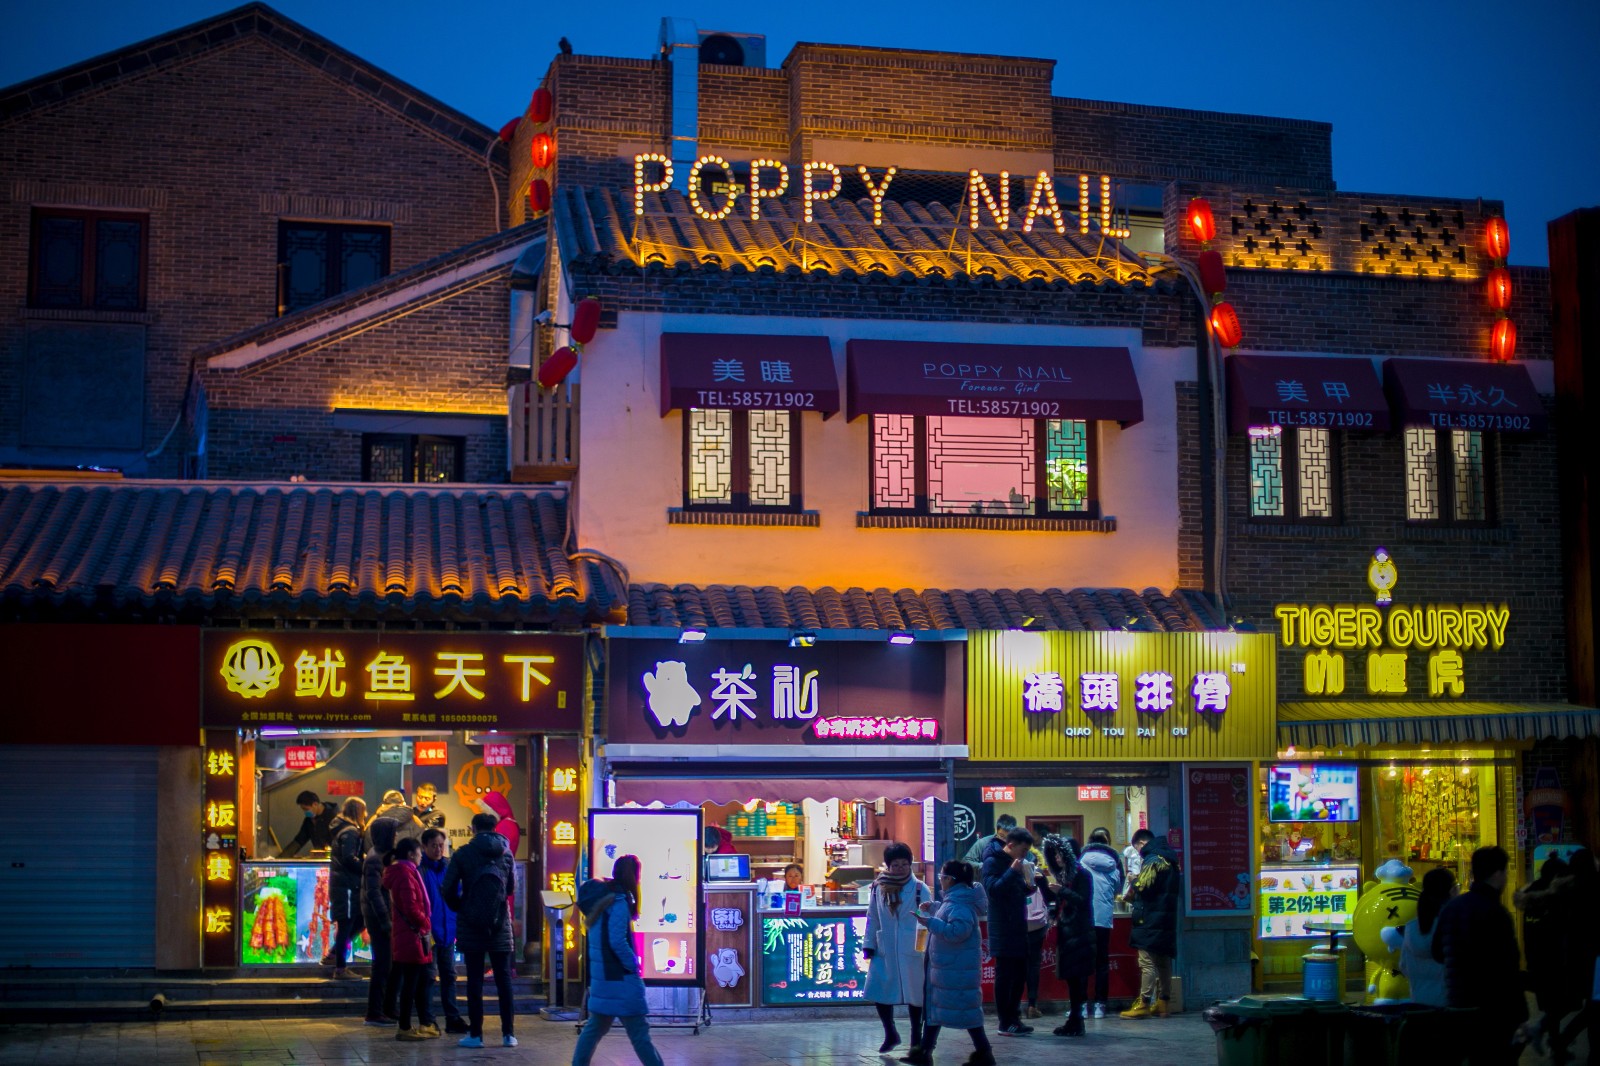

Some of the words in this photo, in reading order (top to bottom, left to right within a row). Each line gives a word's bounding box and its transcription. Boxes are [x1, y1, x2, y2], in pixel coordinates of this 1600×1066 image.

[633, 153, 898, 226] POPPY
[968, 167, 1131, 239] NAIL
[711, 357, 794, 384] 美睫
[923, 362, 1003, 379] POPPY
[1017, 365, 1072, 381] NAIL
[1014, 382, 1040, 395] Girl
[1275, 379, 1351, 404] 美甲
[1428, 381, 1518, 408] 半永久
[697, 390, 815, 408] TEL:58571902
[947, 398, 1060, 416] TEL:58571902
[1268, 410, 1374, 427] TEL:58571902
[1429, 412, 1531, 430] TEL:58571902
[1275, 606, 1383, 648] TIGER
[1387, 607, 1511, 648] CURRY
[293, 647, 556, 703] 鱿鱼天下
[1023, 672, 1231, 712] 橋頭排骨
[1065, 727, 1092, 737] QIAO
[1103, 727, 1125, 737] TOU
[1137, 728, 1156, 737] PAI
[287, 750, 317, 762] 出餐区
[418, 748, 445, 760] 点餐区
[985, 792, 1014, 801] 点餐区
[1080, 789, 1110, 800] 出餐区
[206, 750, 236, 934] 铁板贵族
[1268, 894, 1347, 914] 第2份半價
